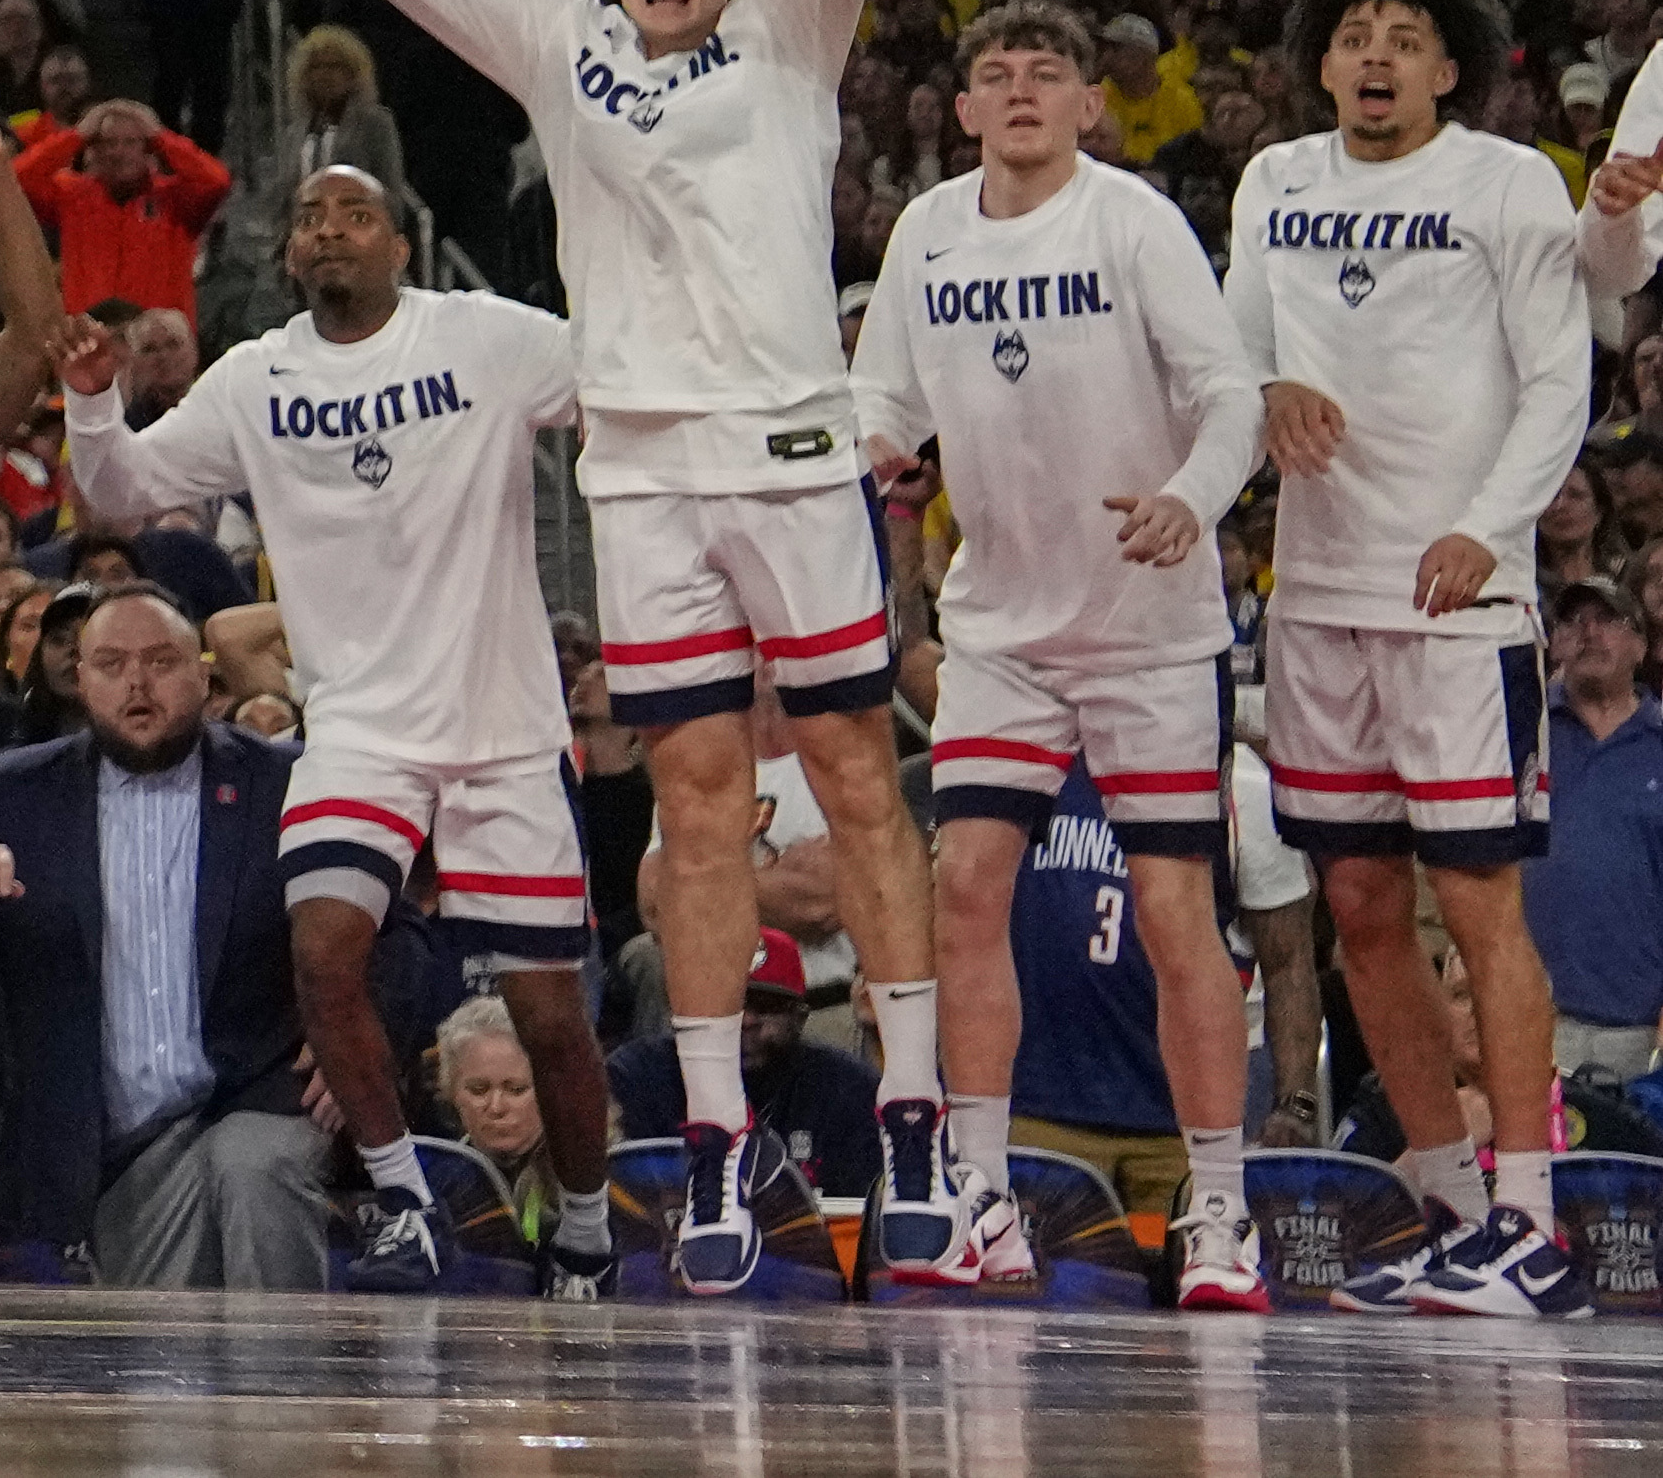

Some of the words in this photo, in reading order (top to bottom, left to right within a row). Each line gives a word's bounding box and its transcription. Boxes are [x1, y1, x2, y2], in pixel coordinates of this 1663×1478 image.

[1267, 206, 1363, 250] LOCK
[1362, 210, 1407, 251] IT
[1404, 209, 1463, 252] IN.
[923, 275, 1011, 327] LOCK
[1017, 273, 1051, 323] IT
[1056, 268, 1114, 319] IN.
[268, 393, 369, 439] LOCK
[374, 381, 407, 430] IT
[412, 367, 473, 420] IN.
[1089, 884, 1125, 966] 3
[1274, 1214, 1343, 1242] FINAL
[1586, 1220, 1653, 1247] FINAL
[1281, 1259, 1347, 1287] FOUR
[1596, 1265, 1660, 1293] FOUR
